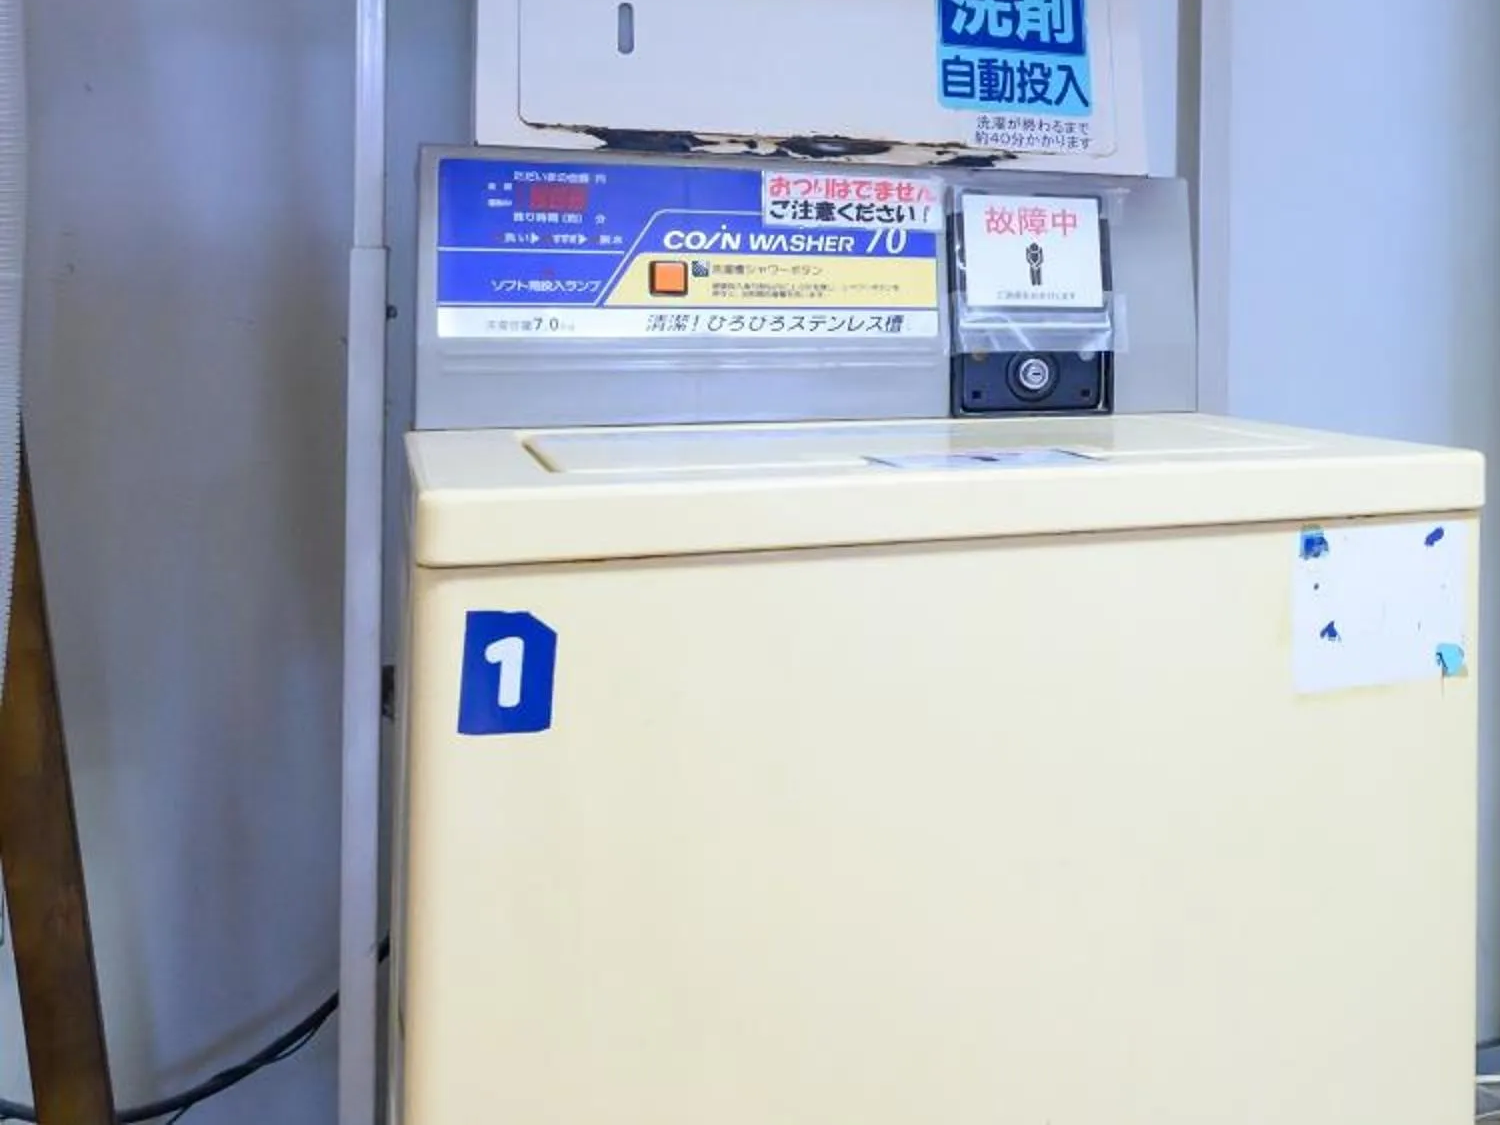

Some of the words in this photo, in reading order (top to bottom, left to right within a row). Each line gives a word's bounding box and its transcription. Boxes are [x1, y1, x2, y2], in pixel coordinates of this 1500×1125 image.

[942, 55, 1089, 107] 自動投入
[977, 115, 1090, 135] 洗濯が終わるまで
[975, 130, 1092, 150] 約40分かかります
[984, 206, 1077, 238] 故障中
[750, 233, 855, 253] WASHER
[484, 634, 524, 709] 1
